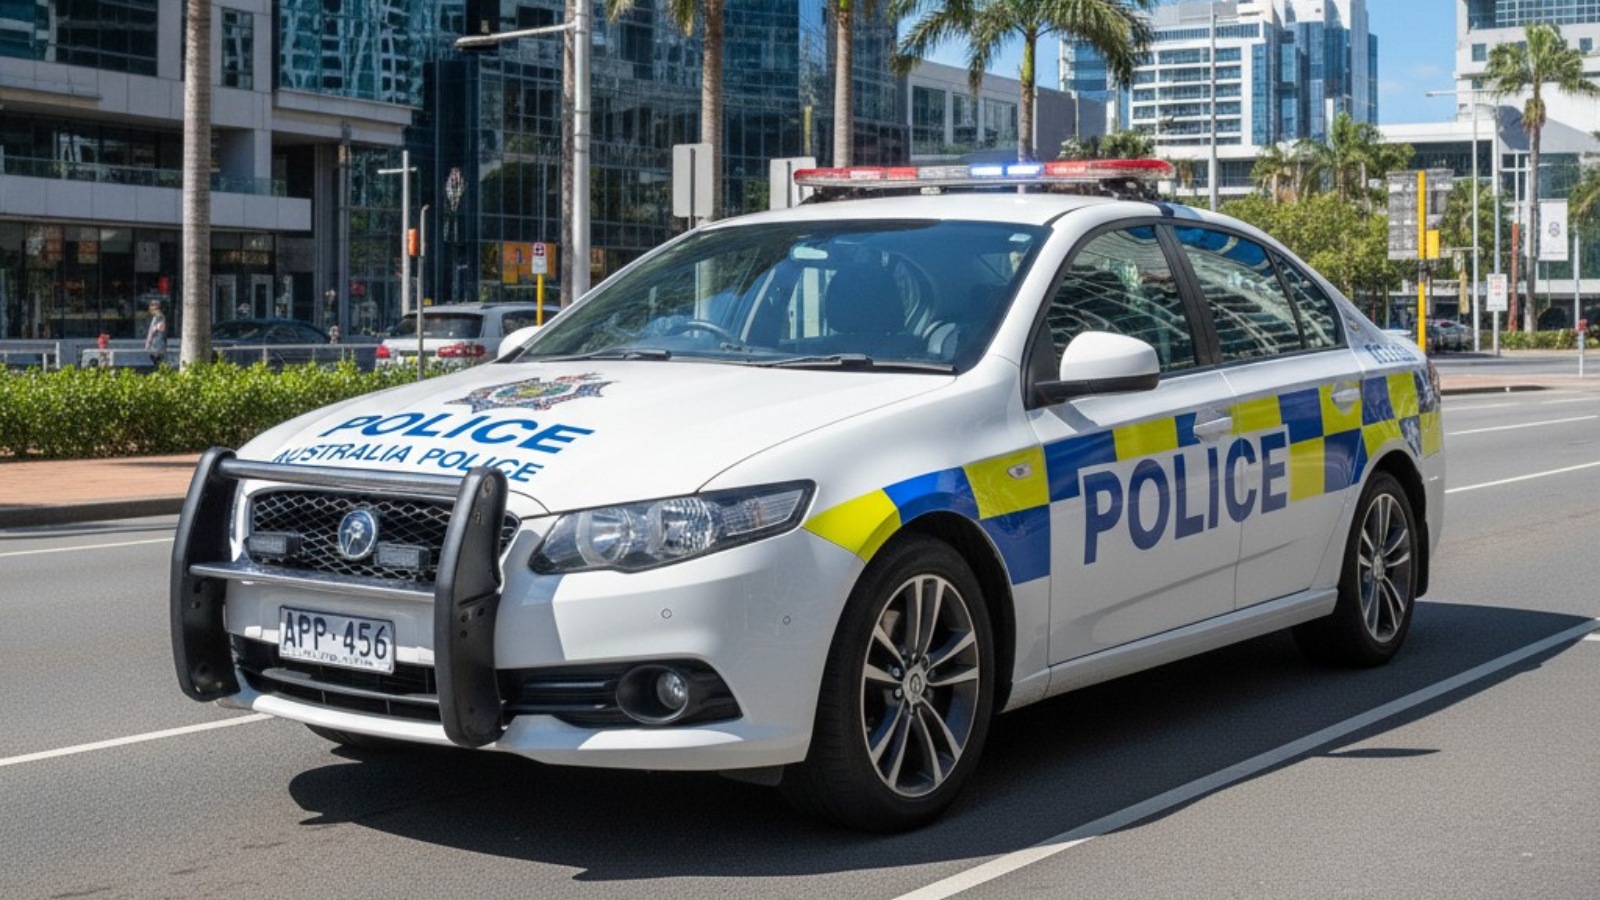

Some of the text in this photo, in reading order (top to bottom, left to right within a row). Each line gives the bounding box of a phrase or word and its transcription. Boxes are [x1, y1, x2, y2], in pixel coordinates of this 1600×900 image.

[272, 443, 412, 464] AUSTRALIA
[317, 413, 595, 454] POLICE
[1083, 431, 1287, 565] POLICE
